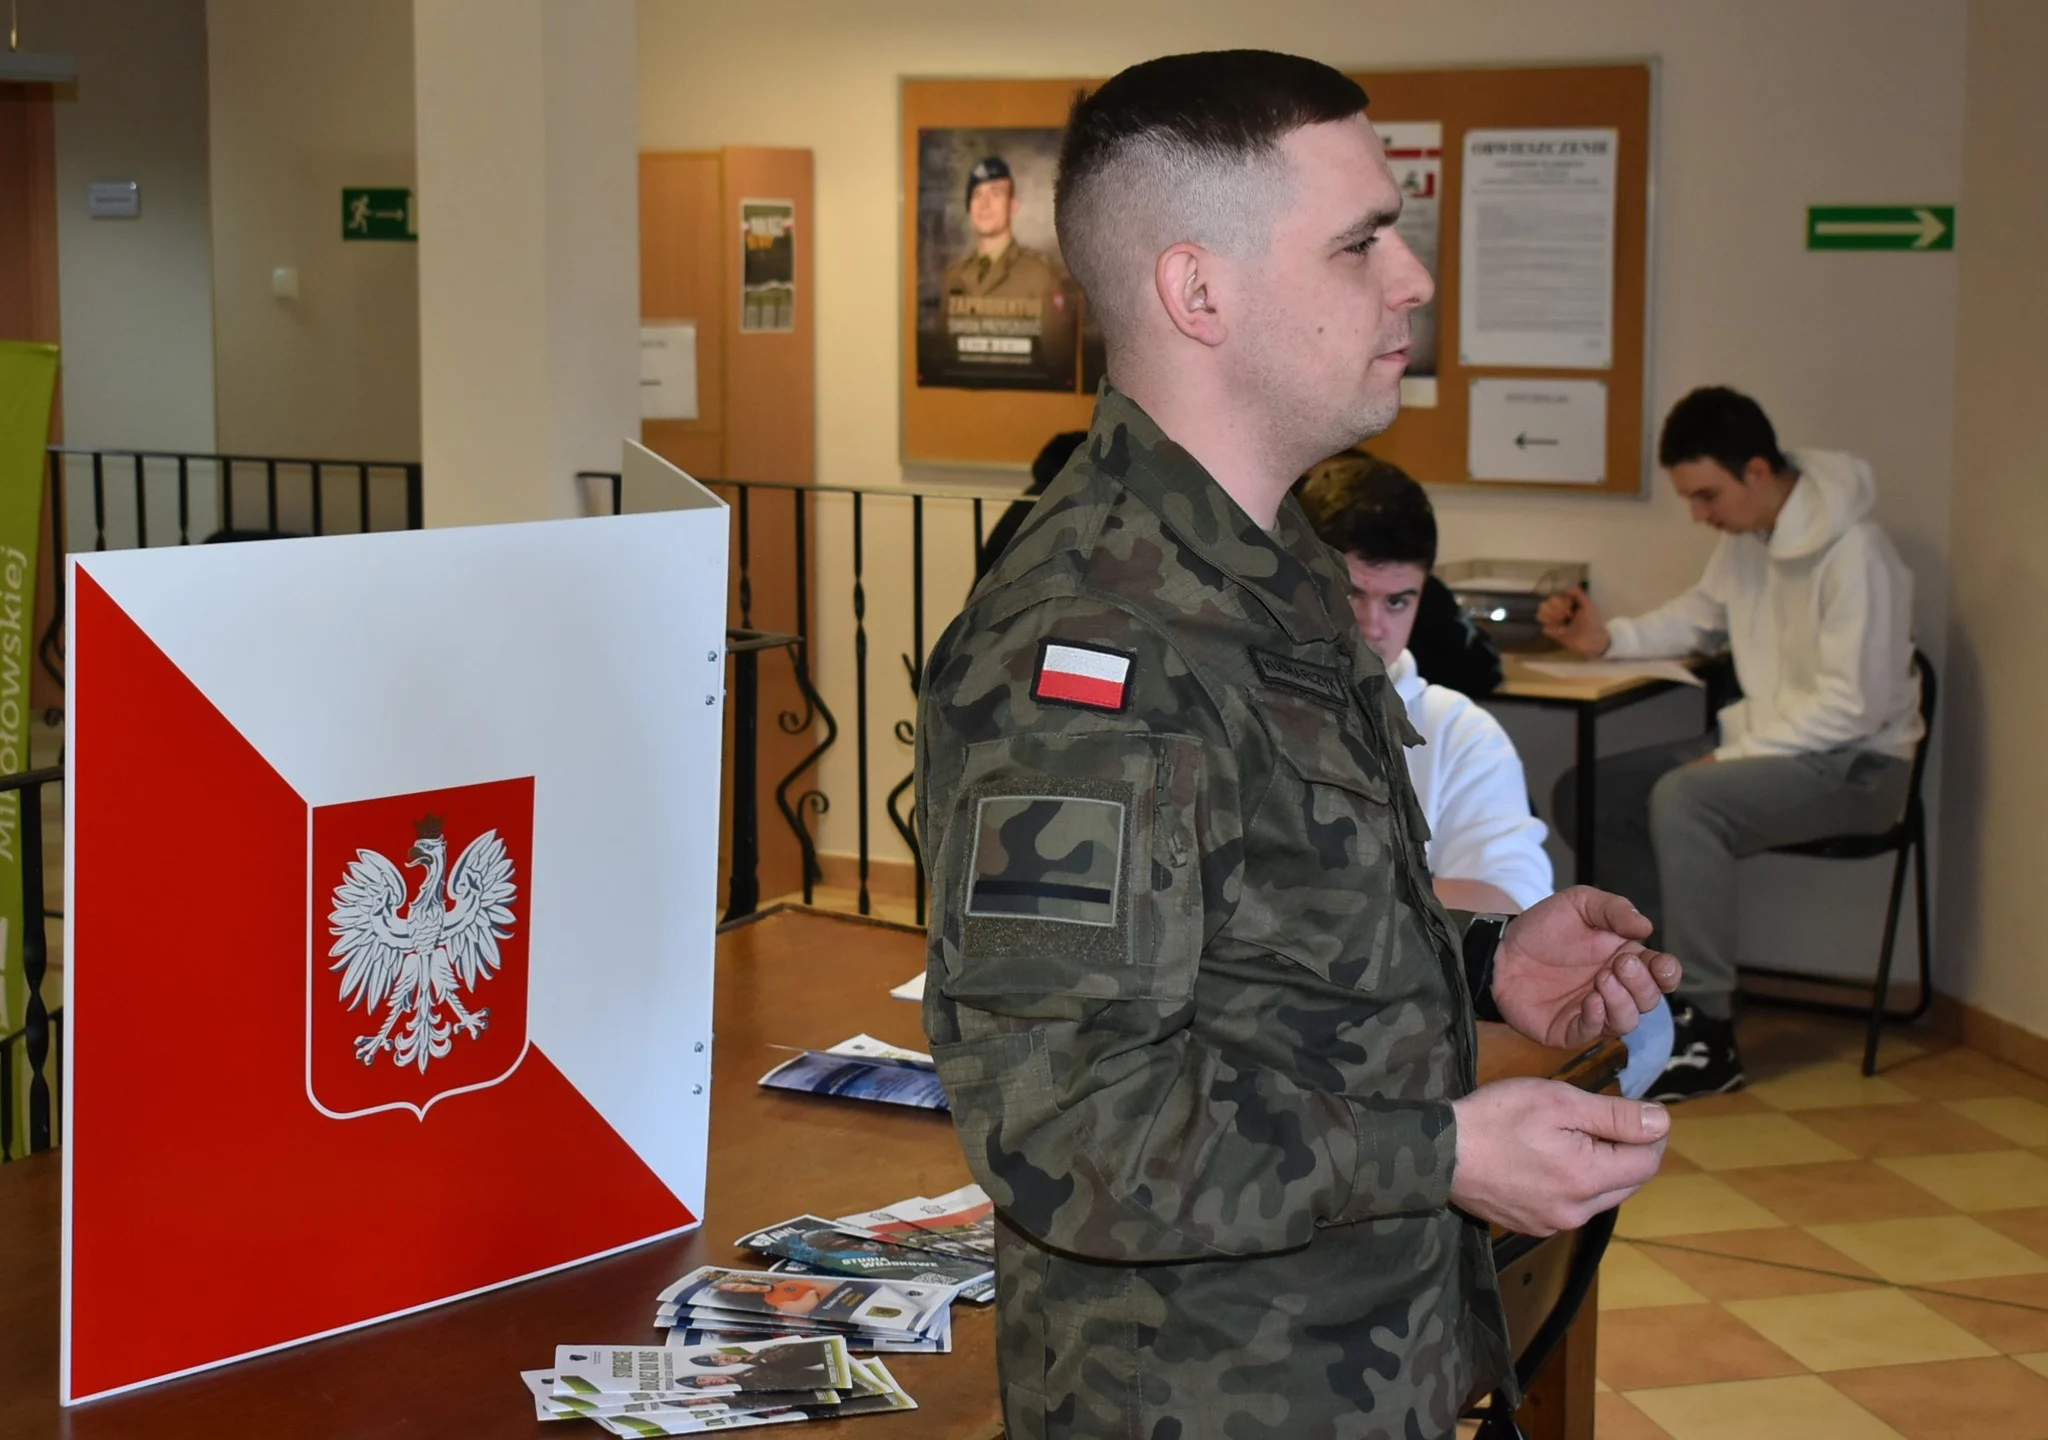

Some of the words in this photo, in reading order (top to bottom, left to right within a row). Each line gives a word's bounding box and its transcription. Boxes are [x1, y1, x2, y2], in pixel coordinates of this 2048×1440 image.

[1470, 141, 1607, 155] OBWIESZCZENIE
[841, 1256, 889, 1266] STUDIA
[860, 1260, 938, 1268] WOJSKOWE
